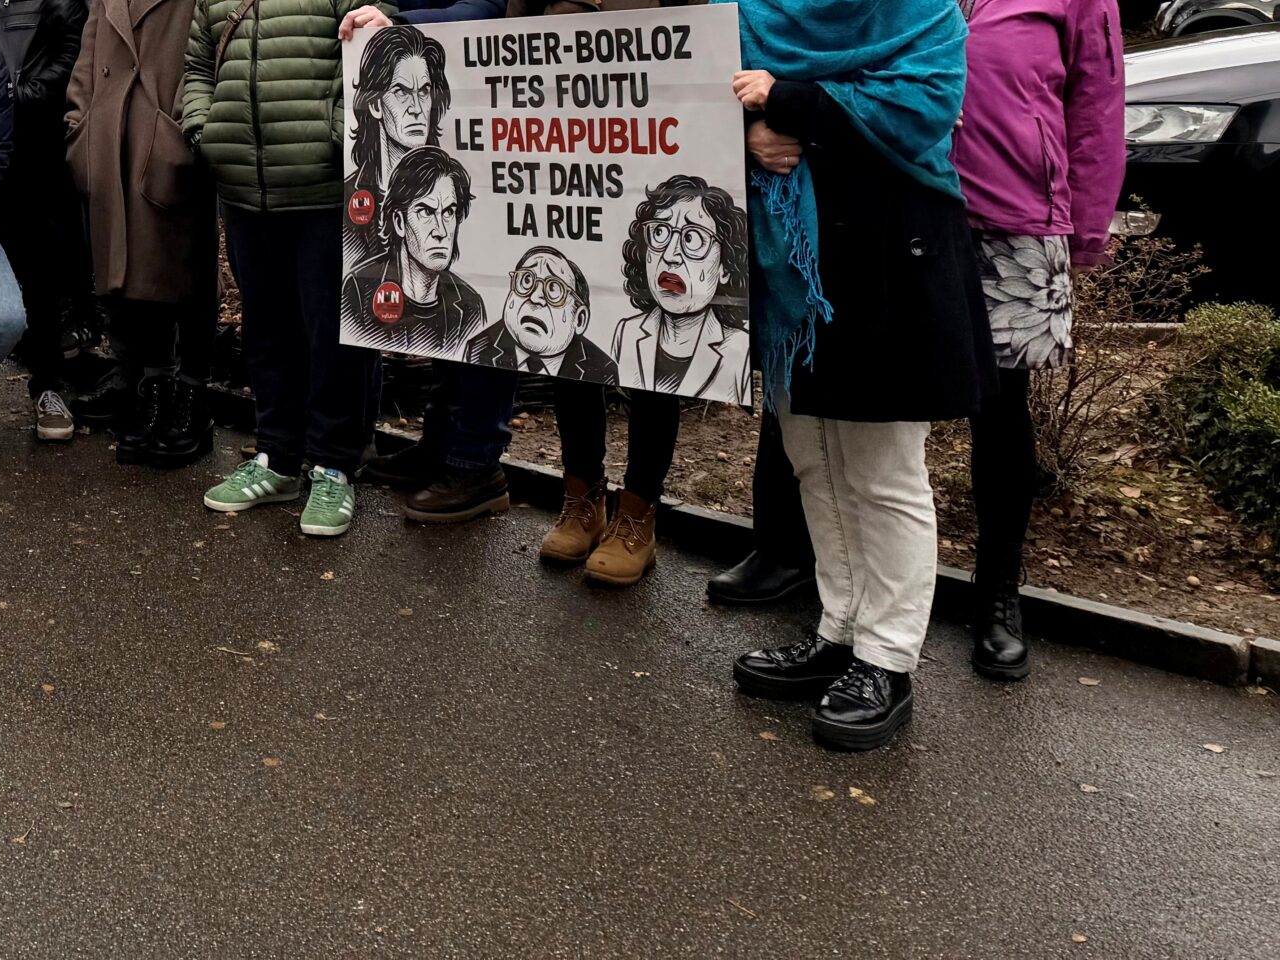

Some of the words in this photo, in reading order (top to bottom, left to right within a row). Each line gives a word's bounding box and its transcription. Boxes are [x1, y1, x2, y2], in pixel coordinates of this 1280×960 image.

[463, 25, 692, 67] LUISIER-BORLOZ
[485, 74, 545, 108] T'ES
[556, 72, 649, 108] FOUTU
[454, 118, 484, 151] LE
[491, 117, 680, 155] PARAPUBLIC
[491, 161, 540, 194] EST
[549, 162, 624, 198] DANS
[507, 202, 539, 237] LA
[547, 202, 603, 241] RUE
